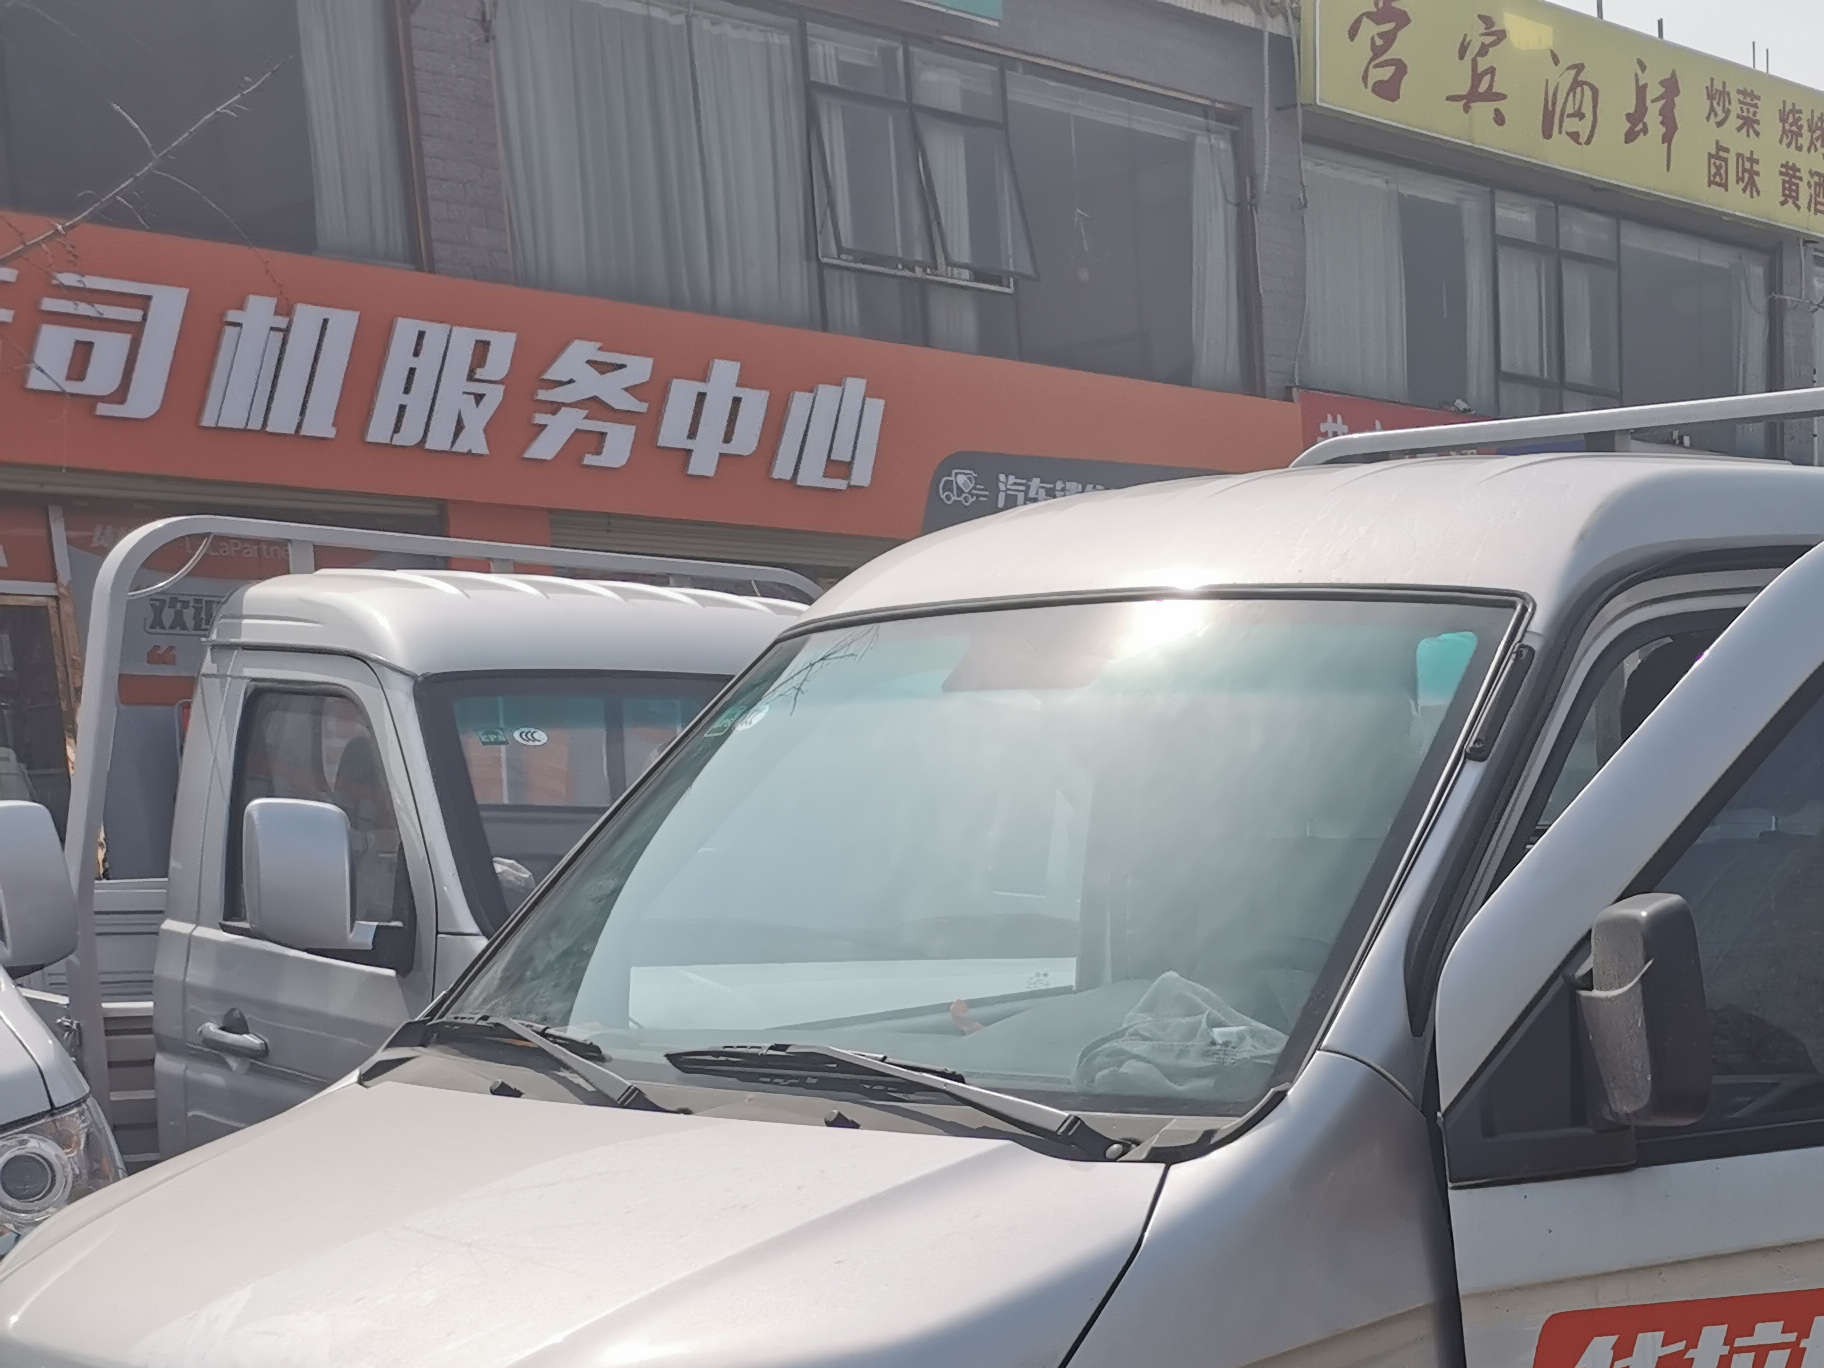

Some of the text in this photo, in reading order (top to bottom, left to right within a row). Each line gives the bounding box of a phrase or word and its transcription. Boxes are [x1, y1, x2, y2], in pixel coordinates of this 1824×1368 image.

[1705, 77, 1762, 140] 炒菜
[1706, 139, 1762, 200] 卤味
[0, 268, 886, 492] 司机服务中心
